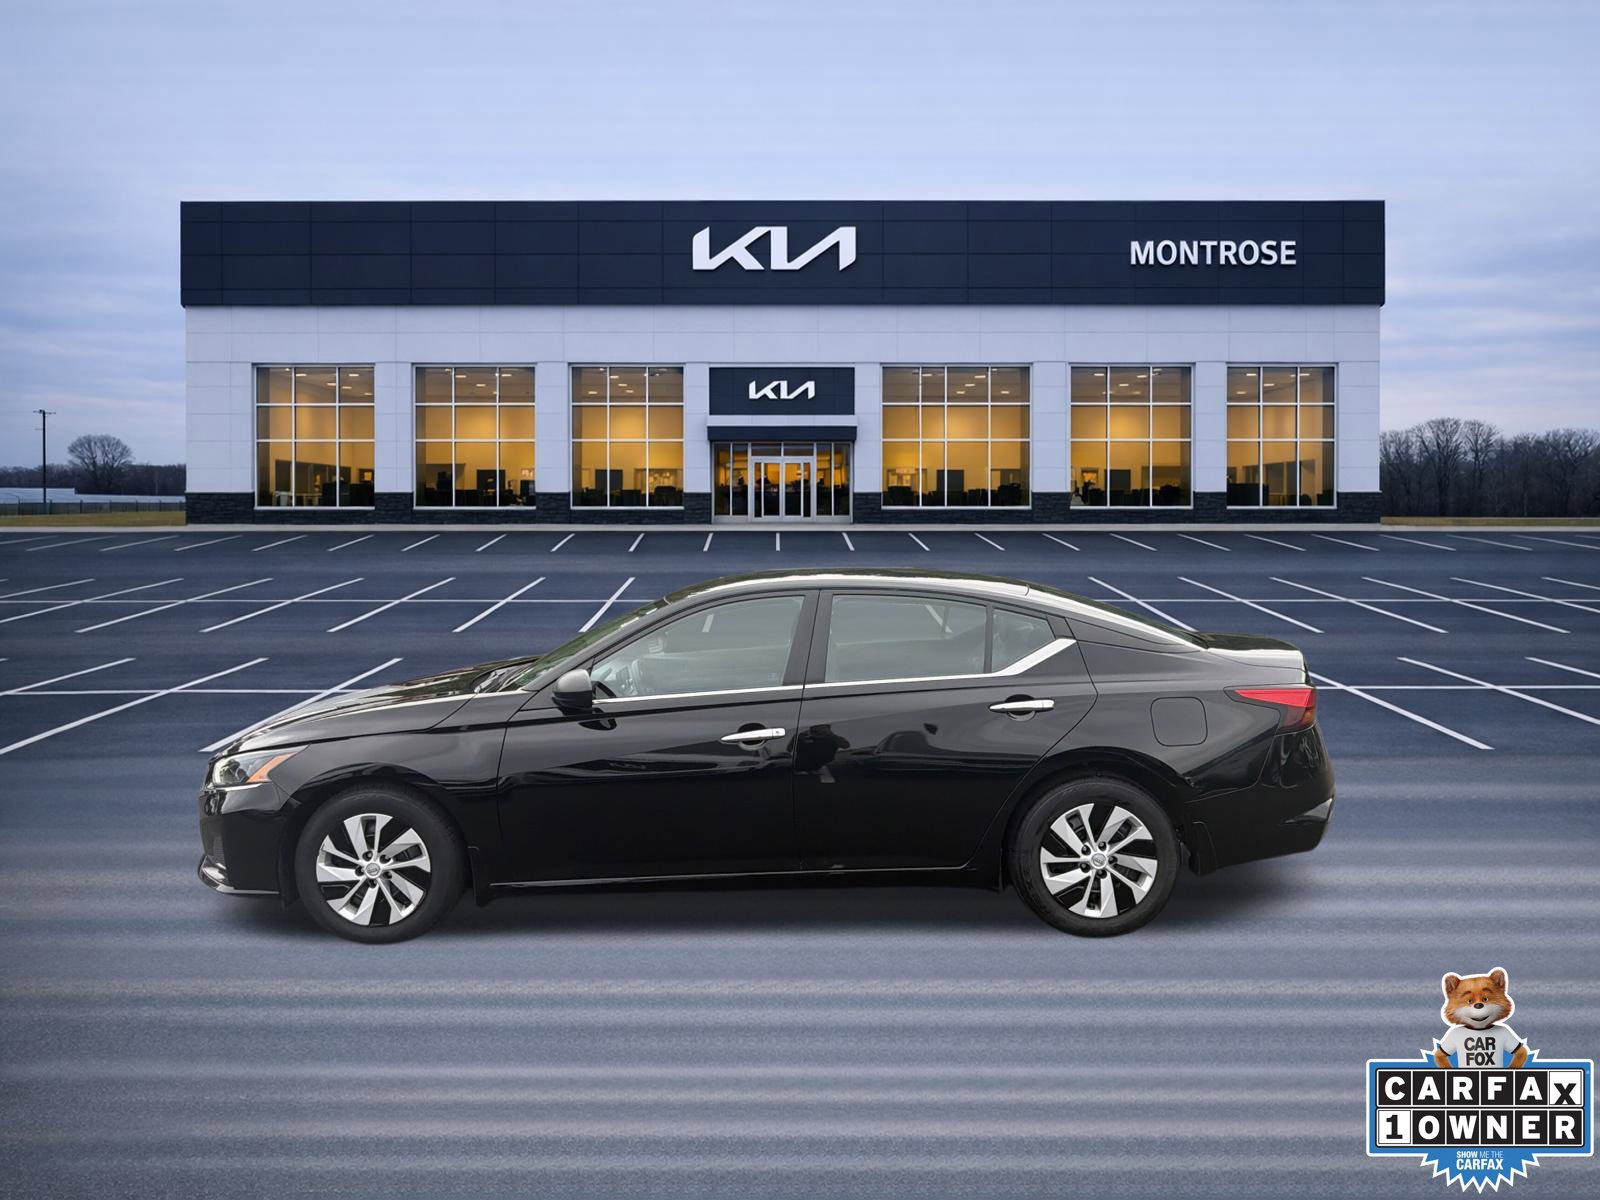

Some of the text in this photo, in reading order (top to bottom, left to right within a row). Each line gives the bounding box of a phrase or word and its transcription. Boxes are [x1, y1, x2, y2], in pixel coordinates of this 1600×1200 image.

[692, 226, 857, 271] KIA
[1130, 240, 1297, 266] MONTROSE
[748, 380, 816, 400] KIA
